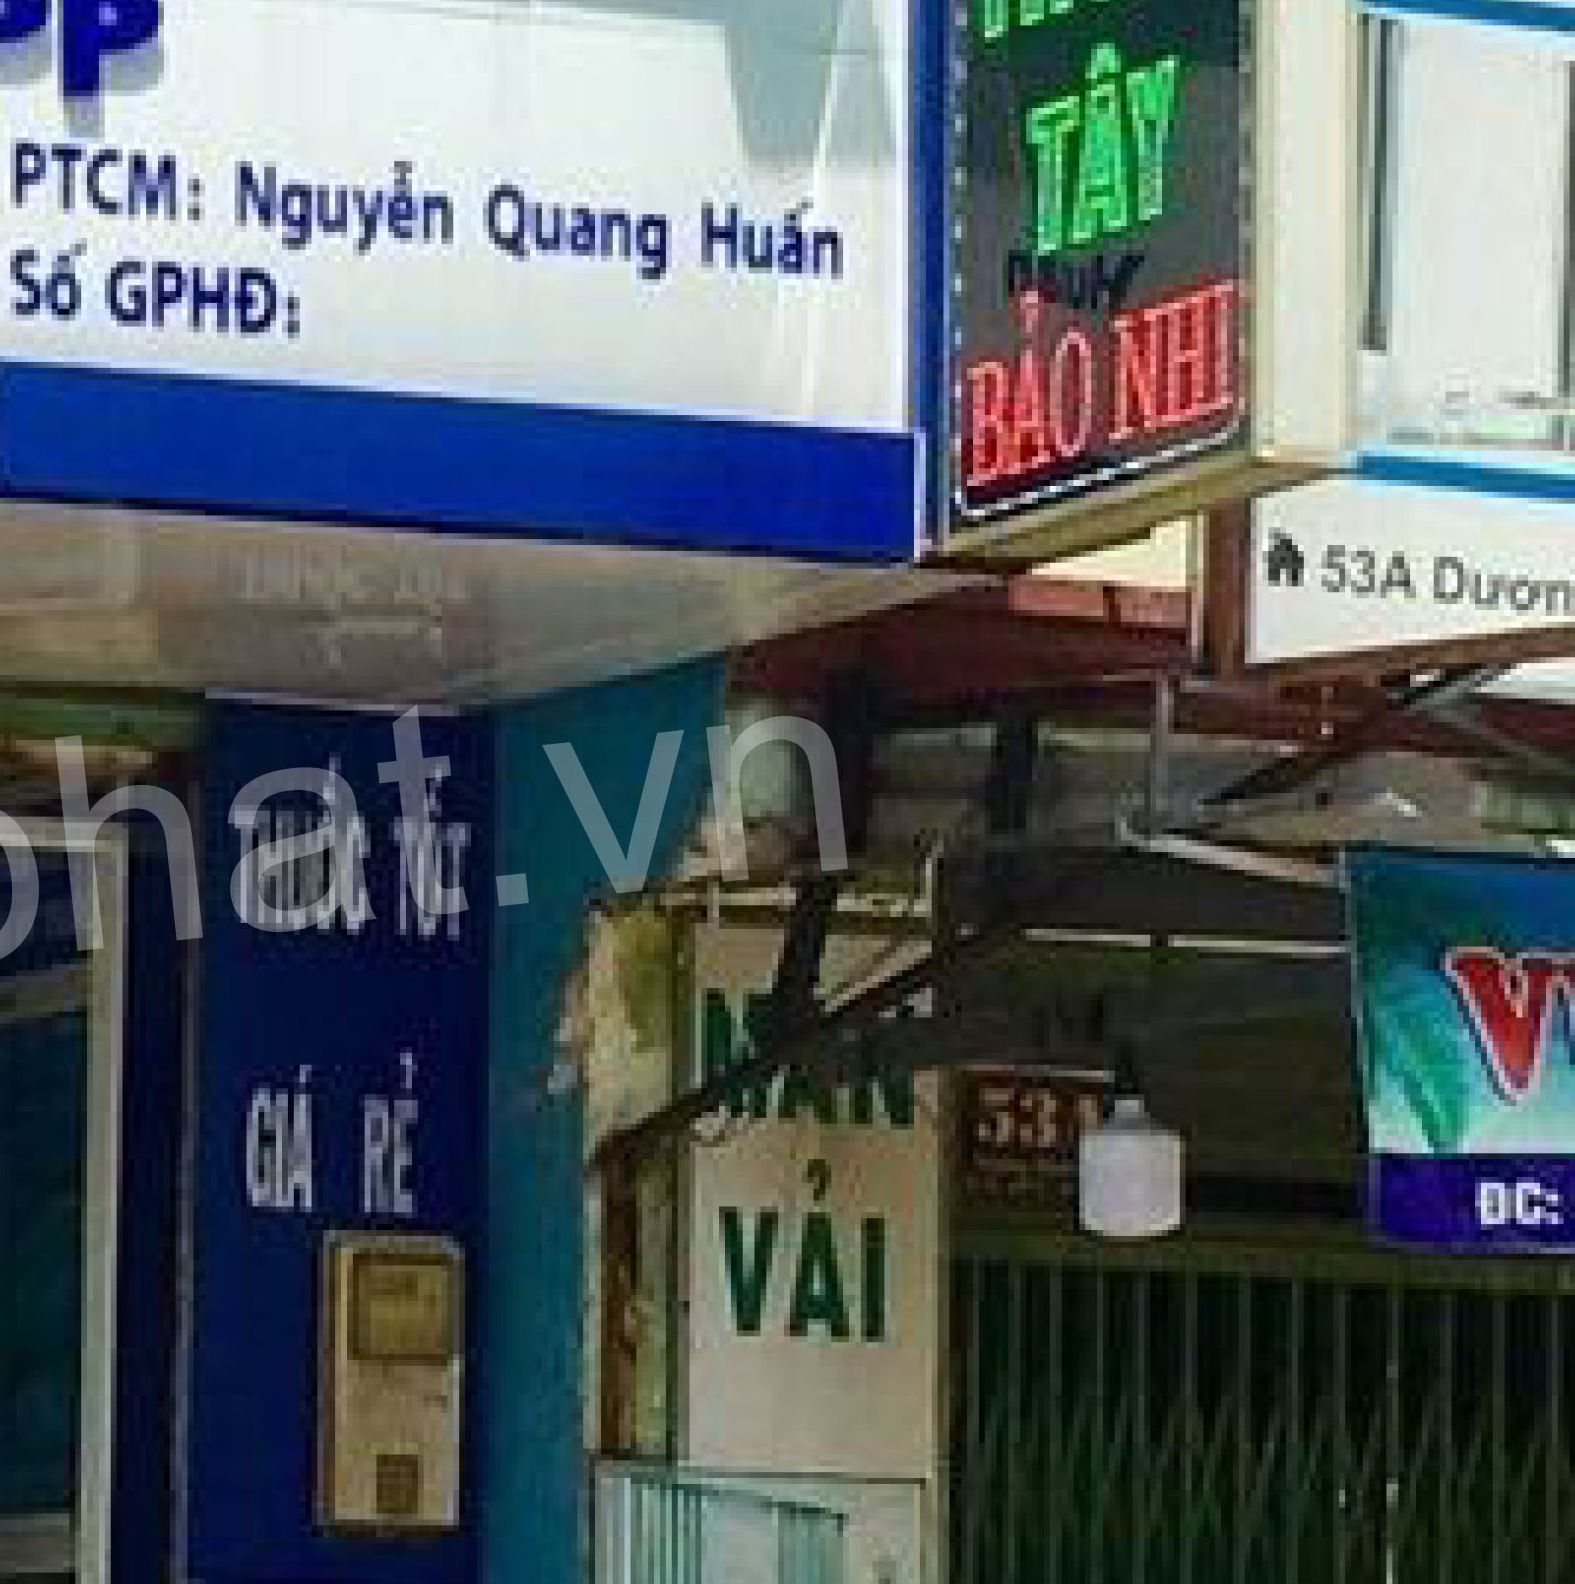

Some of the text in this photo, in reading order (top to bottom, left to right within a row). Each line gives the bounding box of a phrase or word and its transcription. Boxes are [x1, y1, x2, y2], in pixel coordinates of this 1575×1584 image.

[10, 142, 846, 280] PTCM: Nguyễn Quang Huấn
[1023, 40, 1180, 257] TÂY
[10, 238, 302, 340] Số GPHĐ:
[966, 278, 1235, 488] BẢO NHI
[1320, 543, 1418, 599] 53A
[245, 1048, 420, 1216] GIÁ RẺ
[718, 1158, 887, 1344] VẢI
